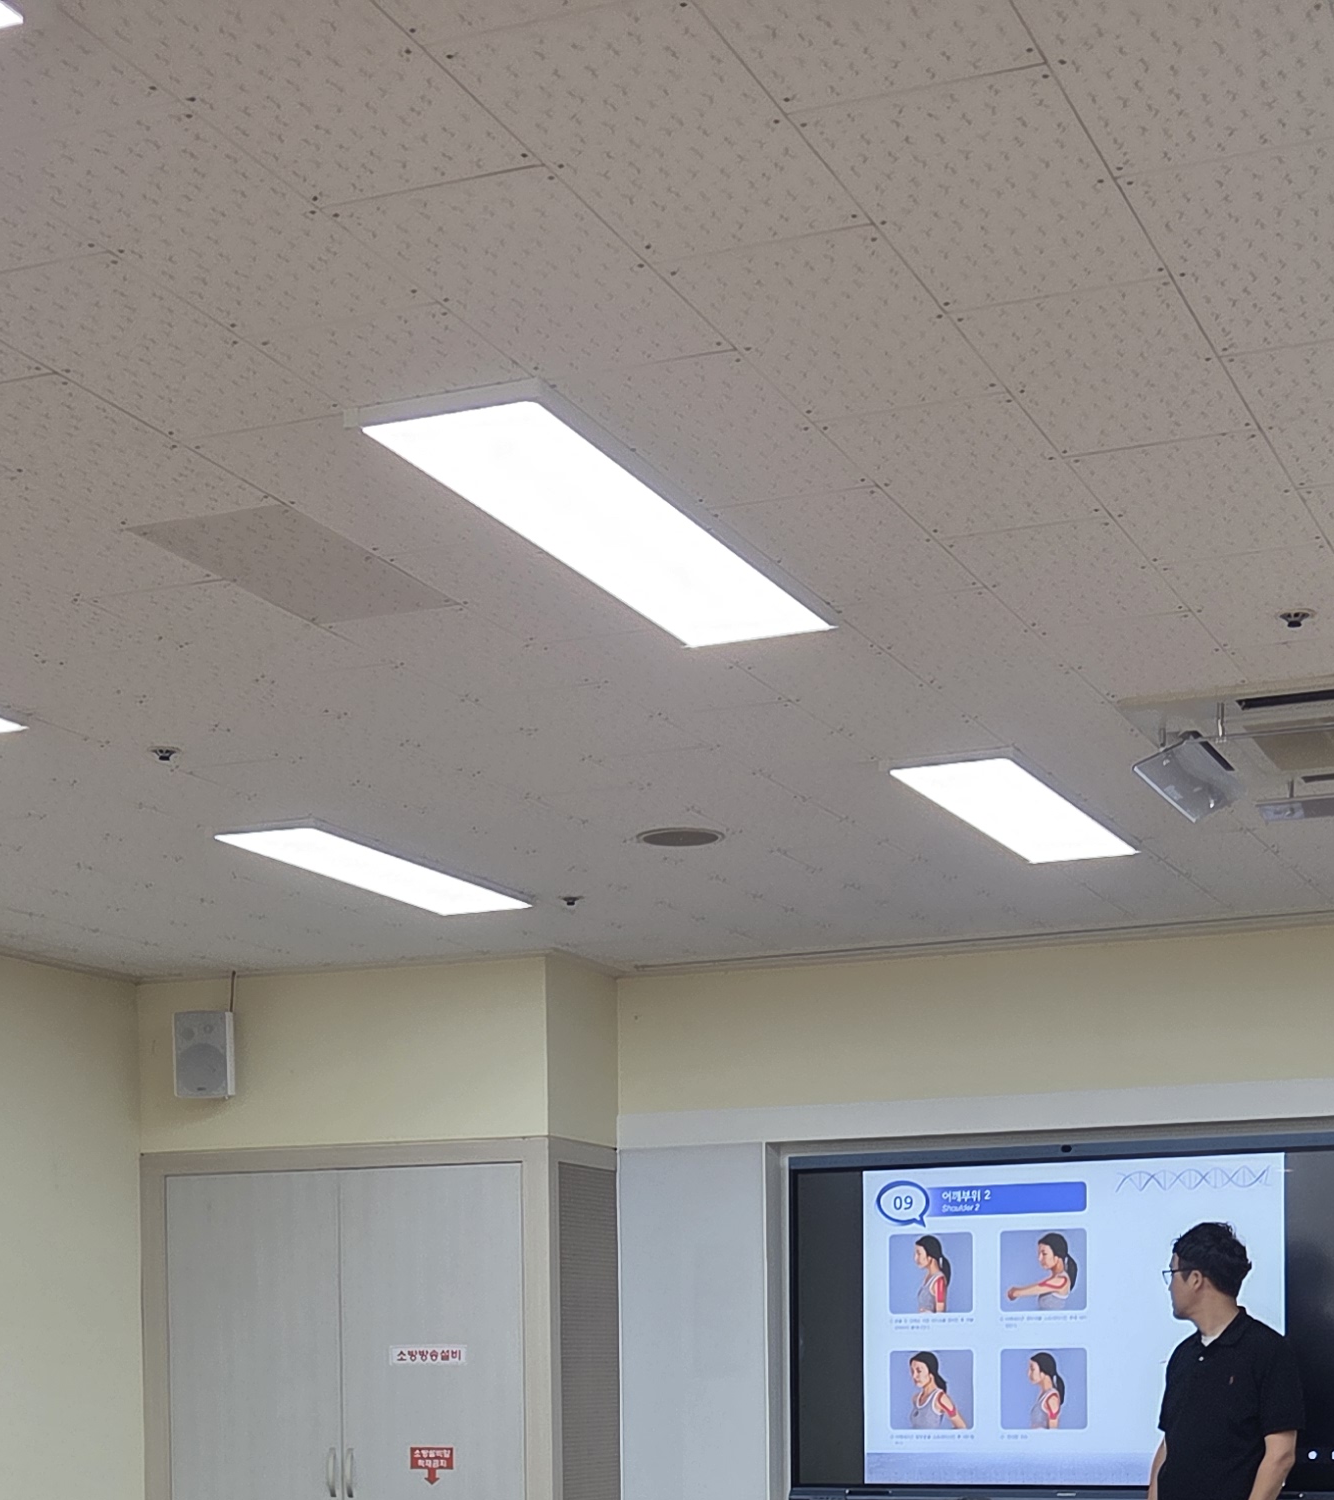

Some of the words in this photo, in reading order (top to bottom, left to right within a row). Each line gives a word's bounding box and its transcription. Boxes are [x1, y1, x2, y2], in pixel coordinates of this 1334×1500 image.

[941, 1189, 981, 1203] 어깨부위
[984, 1189, 992, 1200] 2
[893, 1195, 914, 1211] 09
[941, 1203, 974, 1213] Shoulder
[974, 1203, 980, 1211] 2
[396, 1349, 462, 1362] 소방방송설비
